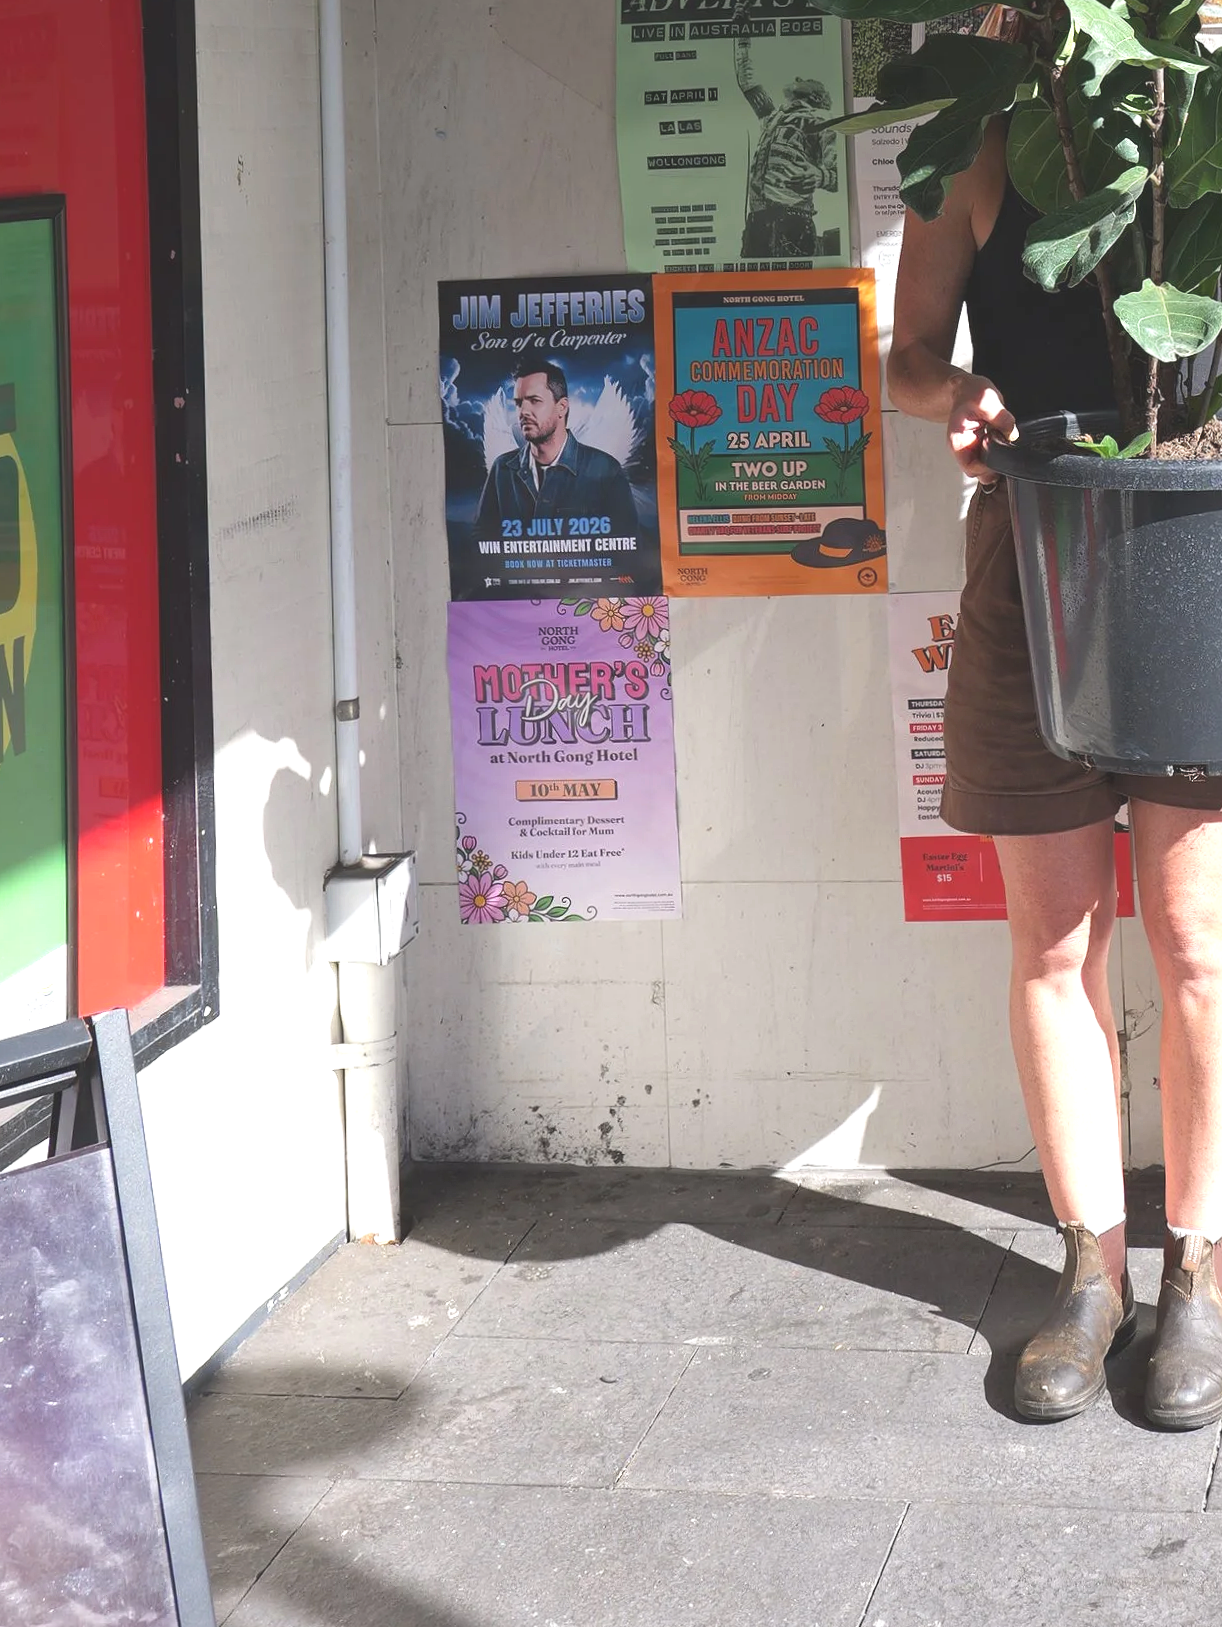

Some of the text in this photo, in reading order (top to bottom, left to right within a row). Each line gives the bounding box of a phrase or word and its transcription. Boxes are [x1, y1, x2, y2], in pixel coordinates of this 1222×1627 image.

[632, 20, 822, 39] LIVE IN AUSTRALIA 2026
[645, 89, 718, 102] SAT APRIL 11
[660, 122, 701, 133] LA LAS
[871, 124, 912, 134] Sounds
[648, 155, 725, 168] WOLLONGONG
[752, 295, 776, 303] GONG
[453, 289, 645, 329] JIM JEFFERIES
[471, 329, 627, 353] Son of a Carpenter
[712, 315, 819, 358] ANZAC
[690, 358, 844, 383] COMMEMORATION
[736, 383, 799, 423] DAY
[727, 431, 811, 450] 25 APRIL
[731, 460, 808, 478] TWO UP
[715, 479, 826, 491] IN THE BEER GARDEN
[768, 493, 798, 501] MIDDAY
[751, 513, 771, 522] FROM
[771, 513, 795, 522] SUNSET
[799, 512, 816, 522] LATE
[502, 517, 612, 537] 23 JULY 2026
[478, 537, 637, 554] WIN ENTERTAINMENT CENTRE
[505, 558, 612, 569] BOOK NOW AT TICKETMASTER
[538, 626, 579, 636] NORTH
[541, 636, 576, 646] GONG
[473, 661, 650, 703] MOTHER'S
[519, 678, 598, 727] Day
[477, 704, 651, 746] LUNCH
[490, 748, 638, 765] at North Gong Hotel
[914, 750, 946, 758] SATURDA
[530, 783, 601, 797] 10th MAY
[508, 816, 625, 827] Complimentary Dessert
[519, 827, 614, 837] & Cocktail for Mum
[511, 850, 533, 860] Kids
[535, 850, 566, 859] Under
[568, 849, 579, 858] 12
[581, 849, 597, 858] Eat
[951, 853, 967, 862] Egg
[926, 864, 964, 872] Martini's
[937, 874, 953, 882] $15
